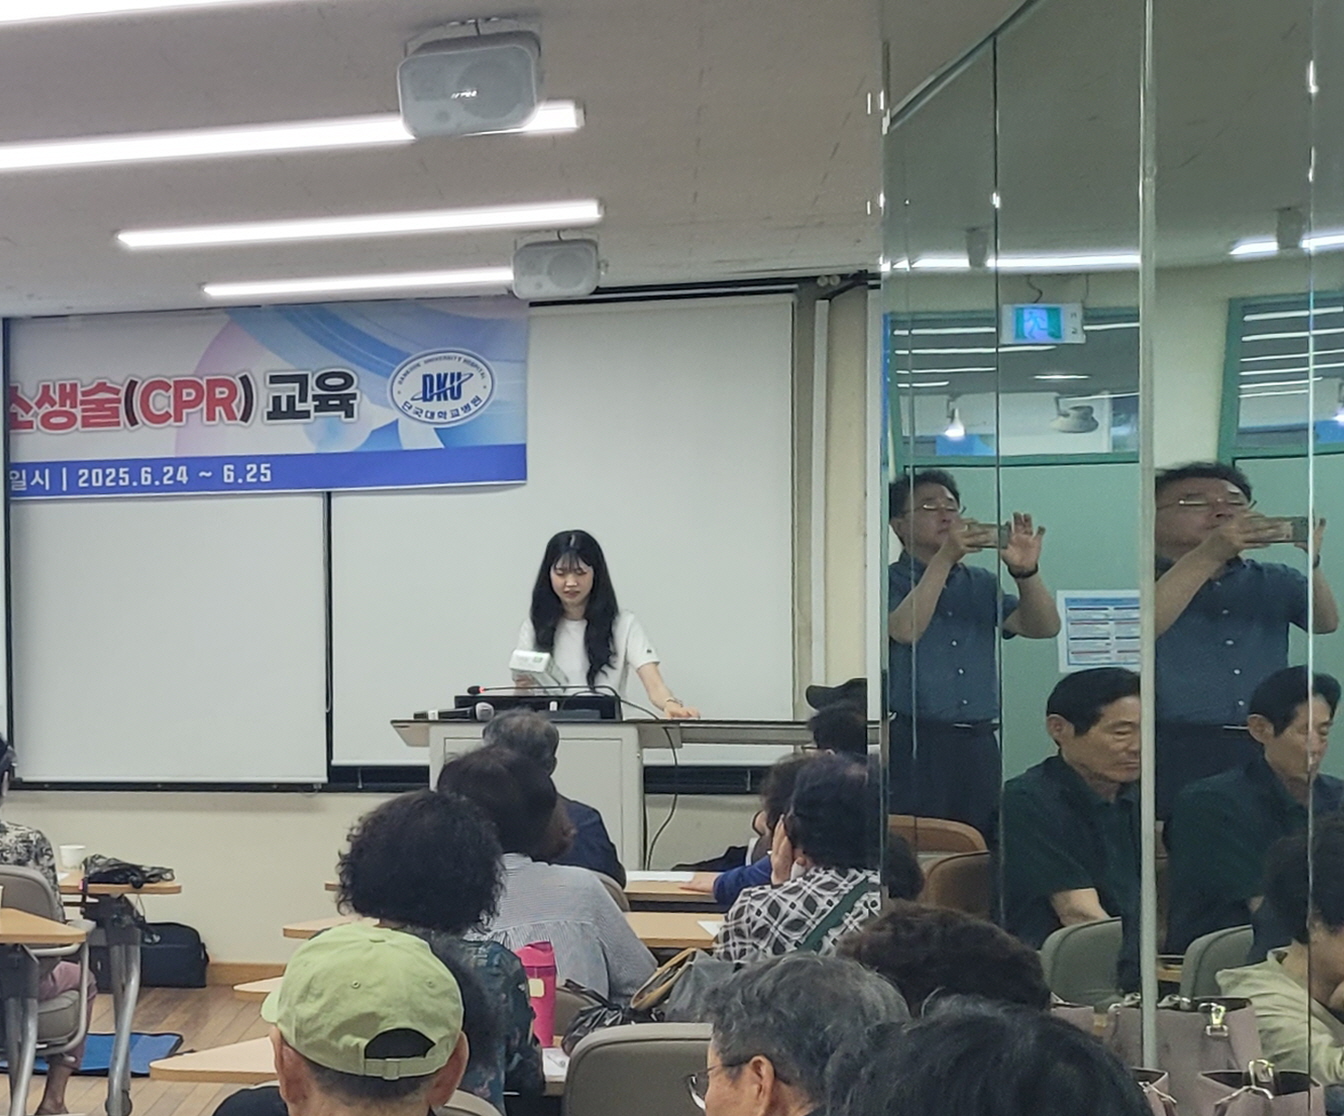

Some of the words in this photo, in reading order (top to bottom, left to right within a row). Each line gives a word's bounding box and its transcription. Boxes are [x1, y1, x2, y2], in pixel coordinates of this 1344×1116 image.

[266, 370, 358, 421] 교육
[421, 371, 463, 402] DKU
[9, 469, 50, 491] 일시
[78, 465, 188, 487] 2025.6.24
[223, 464, 272, 484] 6.25
